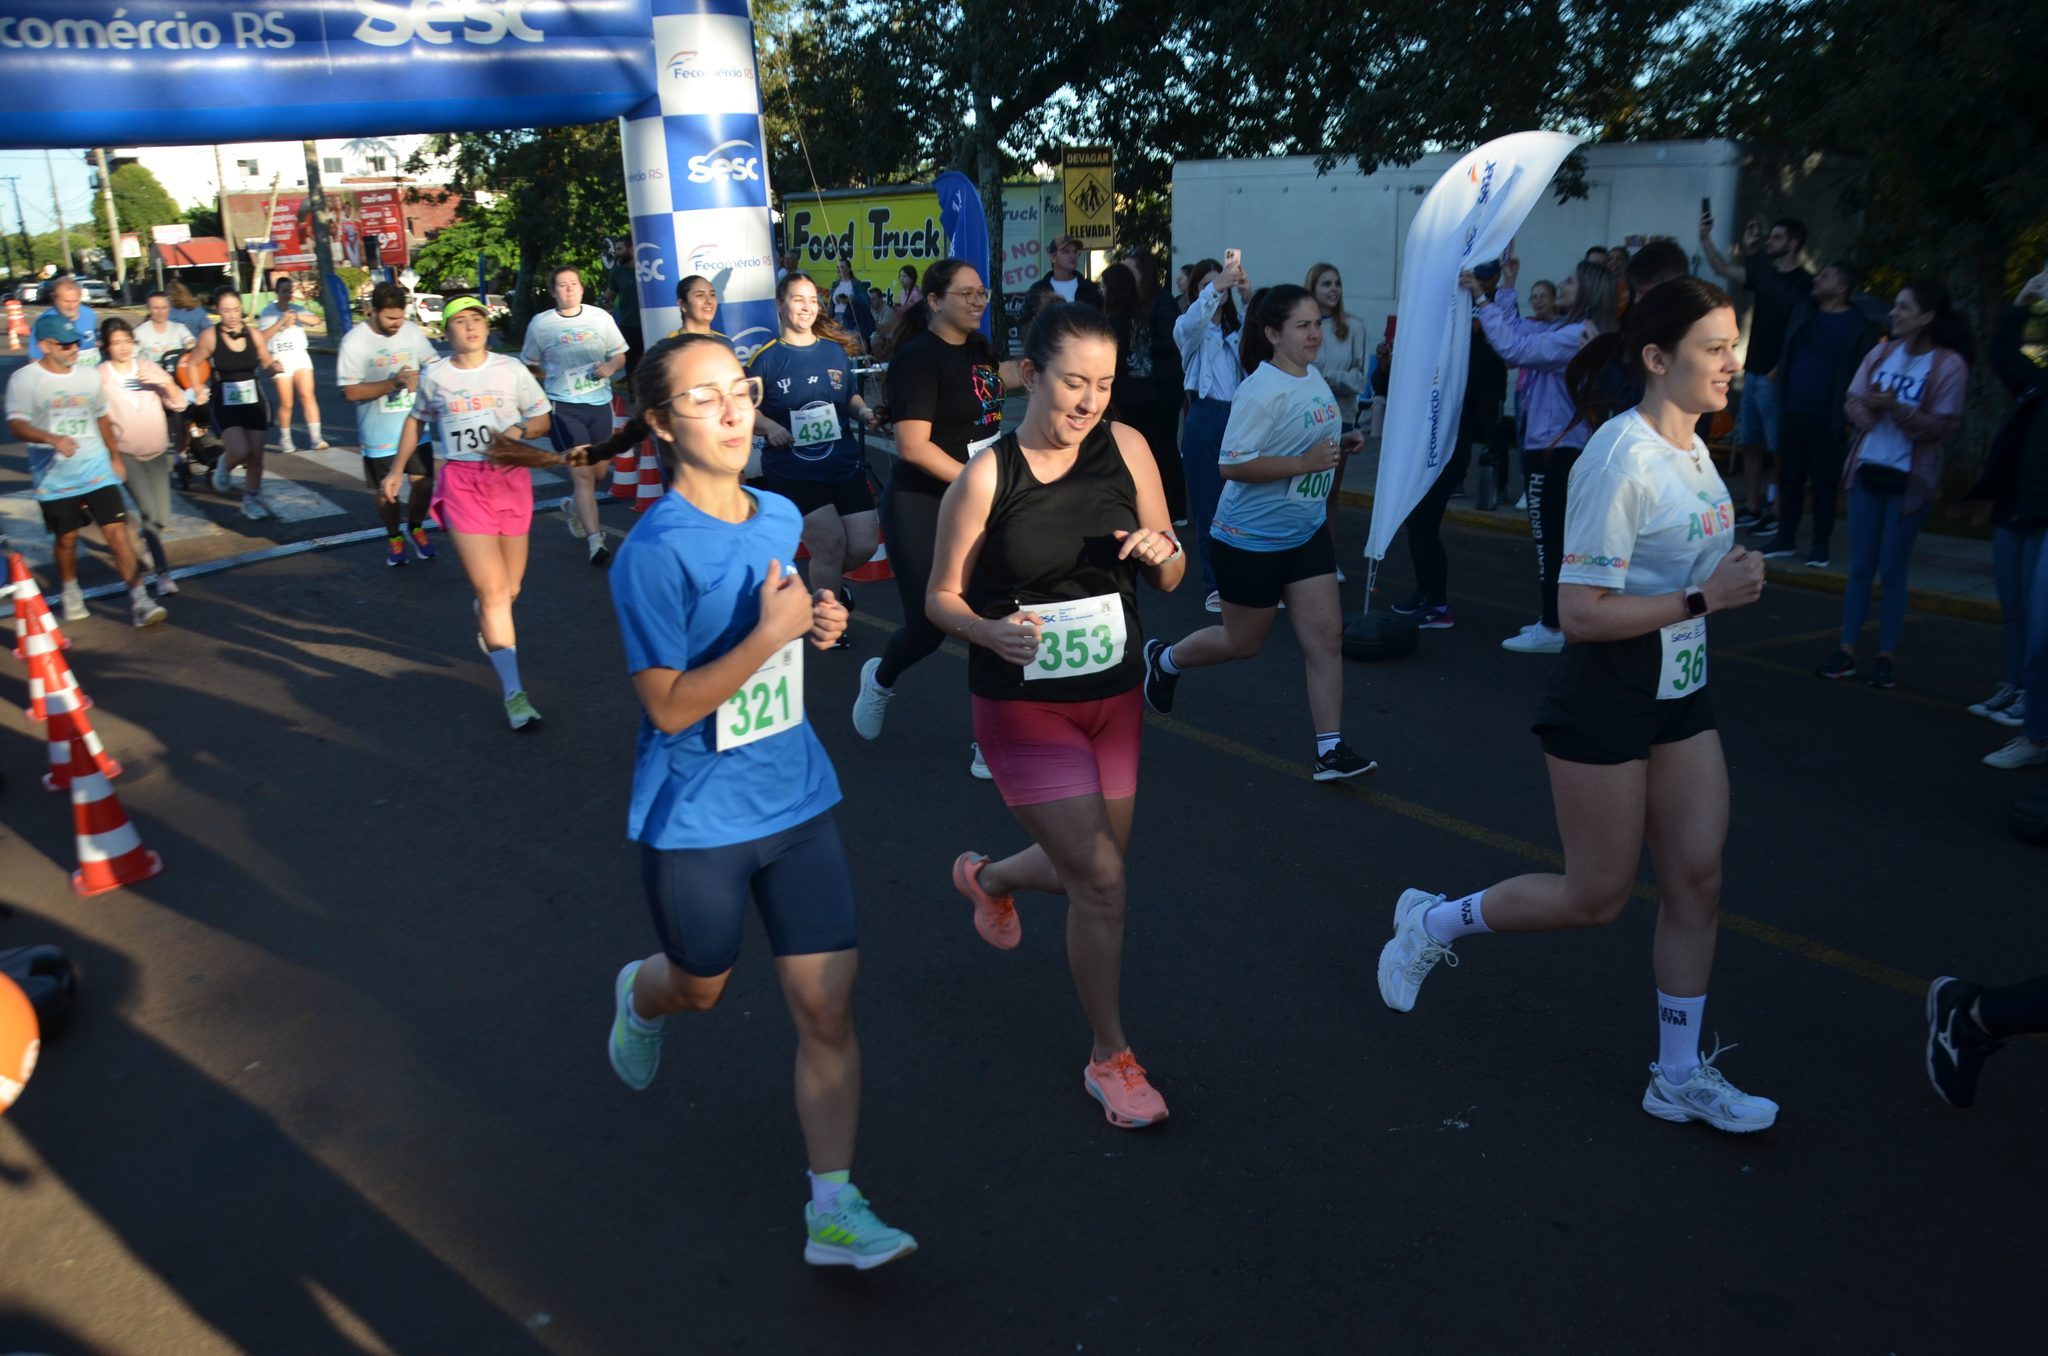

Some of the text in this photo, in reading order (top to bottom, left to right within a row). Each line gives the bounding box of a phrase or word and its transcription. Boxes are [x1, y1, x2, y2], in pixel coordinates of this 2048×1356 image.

[232, 11, 296, 49] RS
[673, 66, 743, 80] Fecoércio
[687, 154, 759, 184] Sesc
[1066, 152, 1109, 164] DEVAGAR
[649, 168, 664, 180] RS
[793, 210, 855, 262] Food
[868, 207, 941, 261] Truck
[1069, 224, 1111, 238] ELEVADA
[1011, 239, 1041, 259] NO
[450, 424, 492, 452] 730
[799, 419, 835, 442] 432
[1296, 472, 1332, 498] 400
[1528, 472, 1545, 540] GROWTH
[1038, 624, 1114, 672] 353
[729, 674, 790, 737] 321
